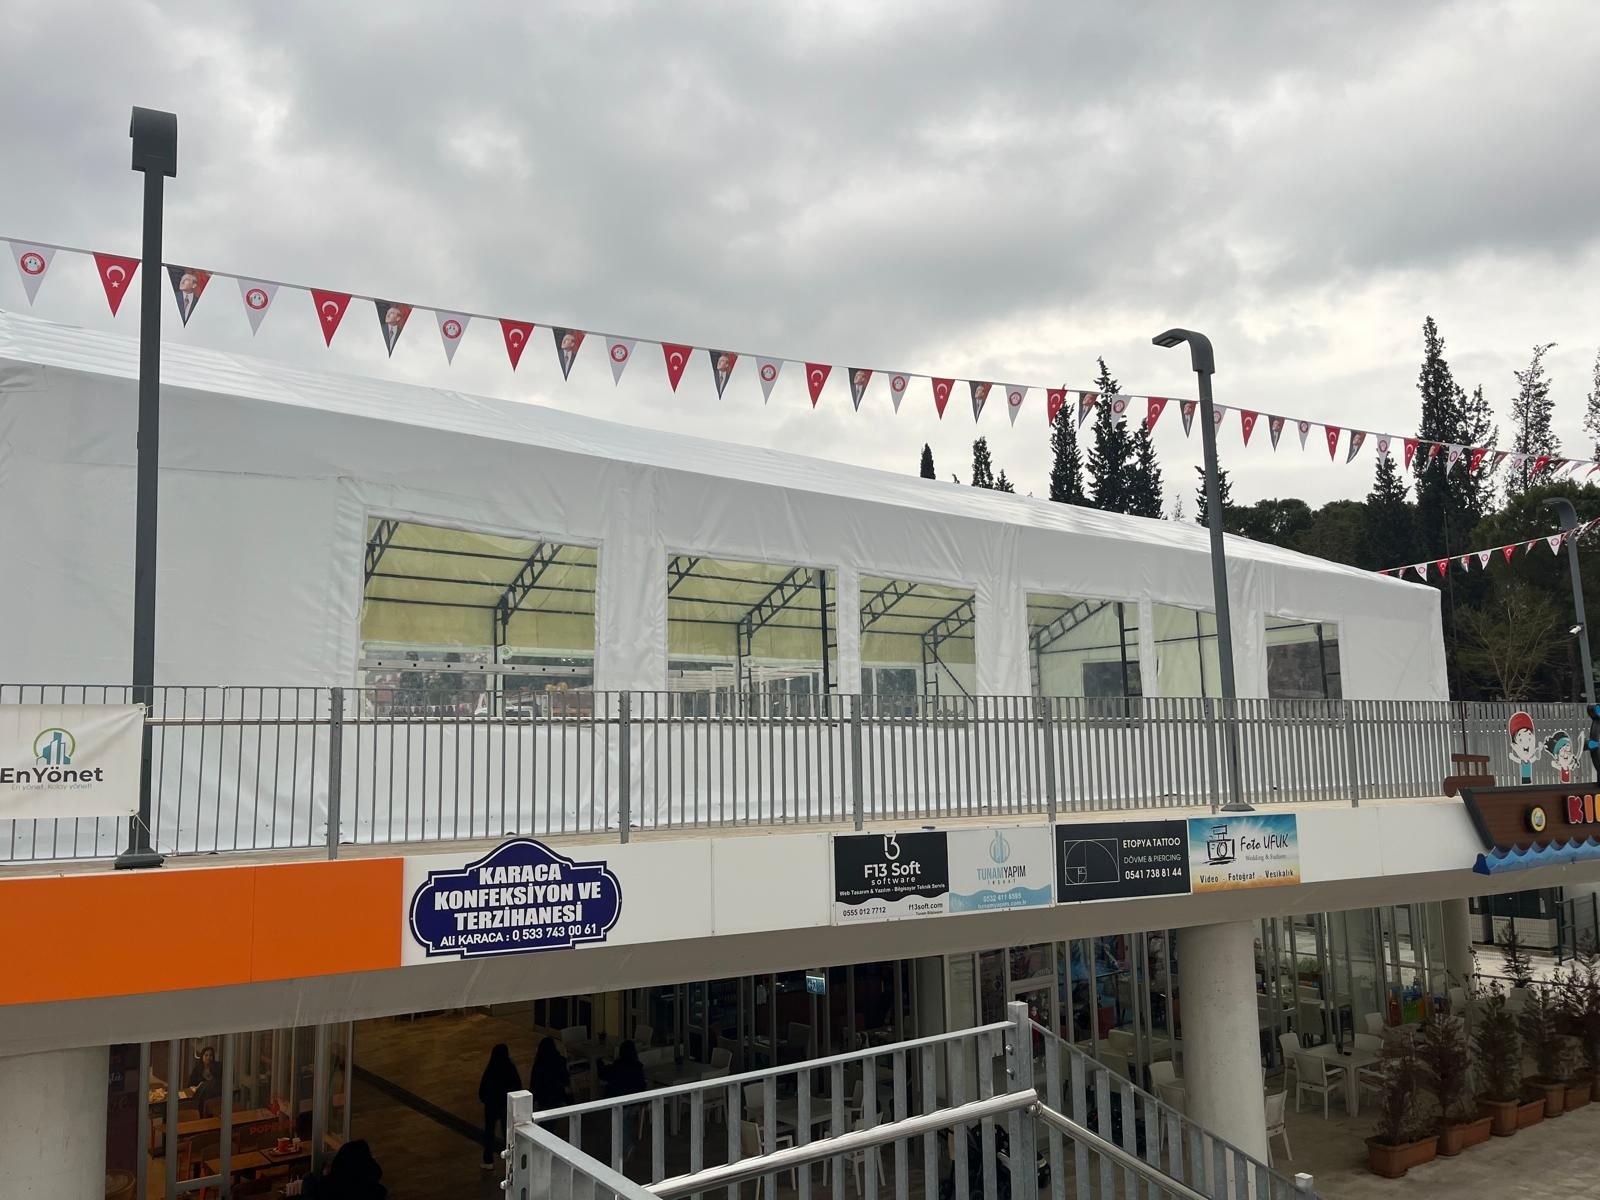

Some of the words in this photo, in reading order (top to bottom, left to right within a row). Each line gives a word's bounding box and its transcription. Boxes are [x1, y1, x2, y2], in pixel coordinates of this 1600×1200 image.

[0, 766, 103, 783] EnYönet
[1122, 838, 1151, 848] ETOPYA
[1152, 837, 1181, 847] TATTOO
[1240, 836, 1261, 851] Foto
[1263, 833, 1289, 849] UFUK
[1123, 855, 1147, 863] DÖVME
[1153, 853, 1181, 862] PIERCING
[479, 863, 562, 885] KARACA
[864, 863, 887, 878] F13
[891, 860, 921, 876] Soft
[976, 865, 1026, 880] TUNAMYAPIM
[1125, 869, 1144, 879] 0541
[1146, 869, 1160, 878] 738
[1161, 868, 1170, 877] 81
[1172, 867, 1182, 876] 44
[1199, 874, 1219, 883] Video
[1228, 871, 1255, 881] Fotoğraf
[871, 877, 916, 885] software
[434, 883, 574, 910] KONFEKSİYON
[577, 881, 601, 900] VE
[454, 901, 583, 931] TERZİHANESİ
[458, 932, 504, 945] KARACA
[512, 929, 520, 941] 0
[522, 928, 543, 939] 533
[546, 927, 565, 938] 743
[568, 924, 582, 936] 00
[584, 923, 597, 934] 61
[248, 1119, 297, 1135] POPE
